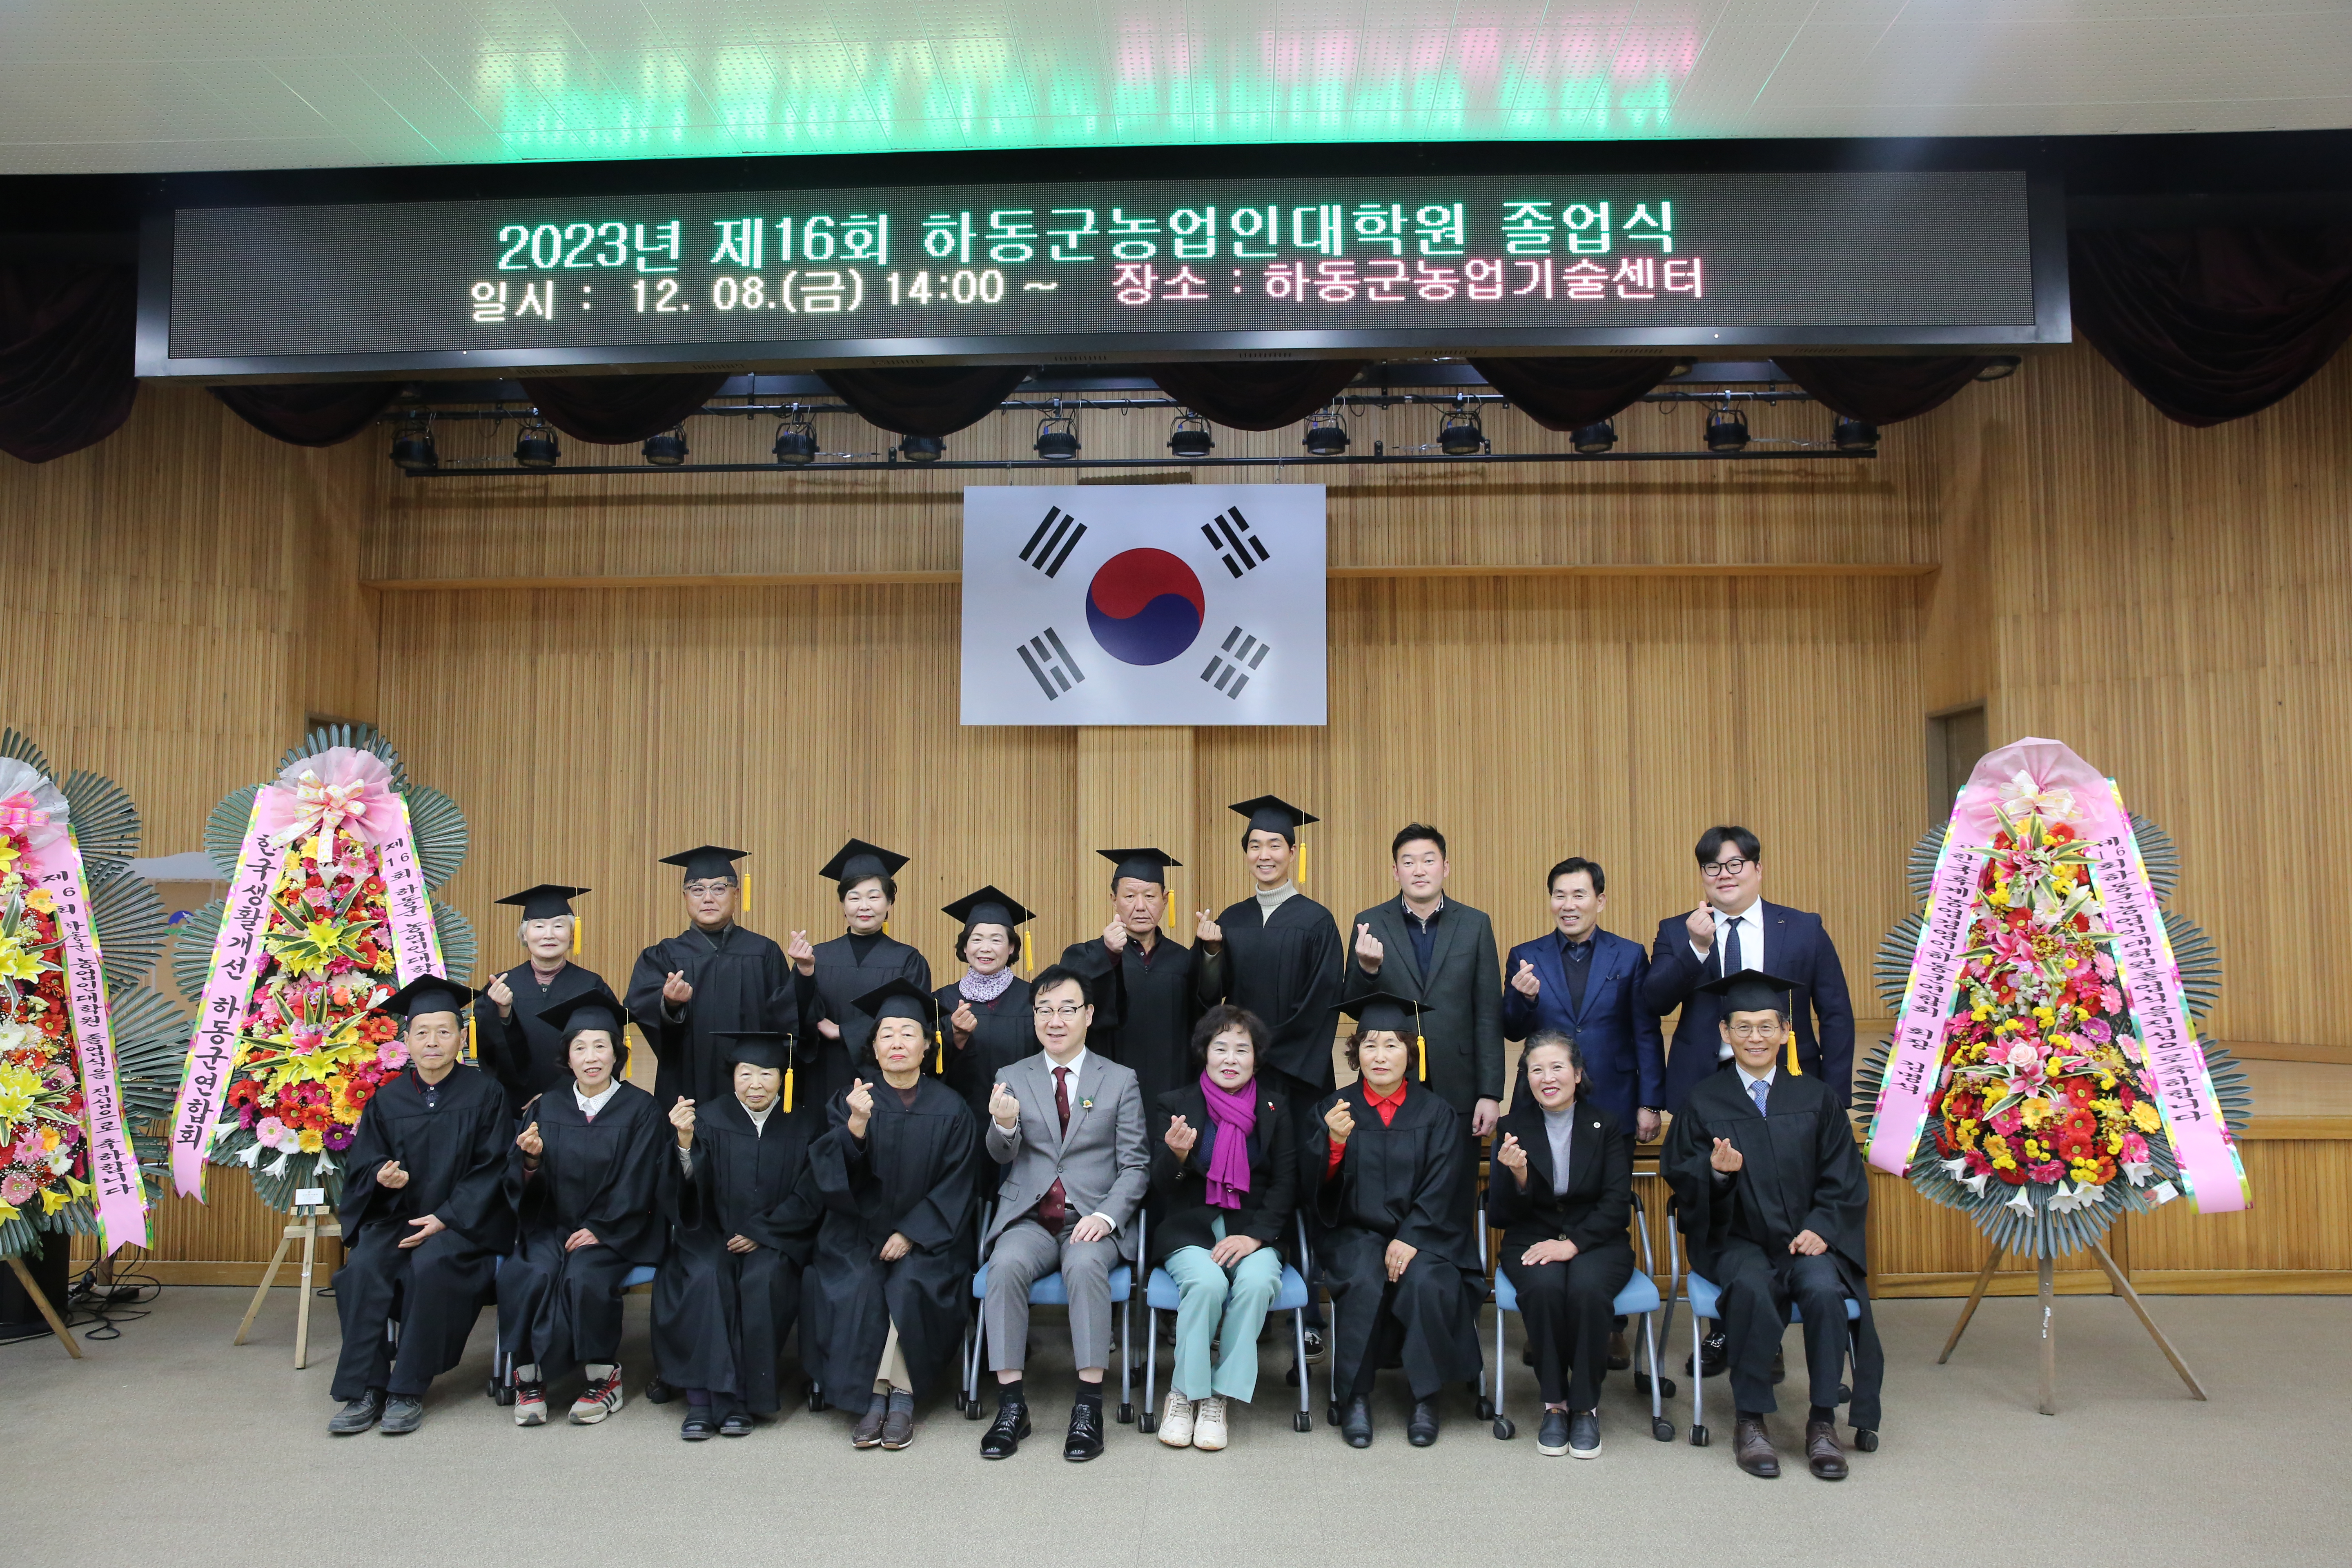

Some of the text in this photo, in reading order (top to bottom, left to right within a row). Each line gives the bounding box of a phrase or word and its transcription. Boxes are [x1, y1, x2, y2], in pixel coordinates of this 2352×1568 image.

[498, 200, 1673, 273] 2023년 제16회 하동군농업인대학원 졸업식
[470, 279, 555, 324] 일시
[632, 277, 690, 314] 12.
[711, 267, 865, 314] 08.(금)
[886, 268, 1006, 307] 14:00
[1112, 263, 1209, 306] 장소
[1263, 256, 1704, 304] 하동군농업기술센터
[393, 884, 424, 917] 하동군
[399, 922, 437, 979] 농업인대학
[42, 871, 135, 1195] 제6회 하동군 농업인대학원 졸업식을 진심으로 축하합니다
[1903, 1026, 1935, 1050] 회장
[176, 995, 240, 1150] 하동군연합회
